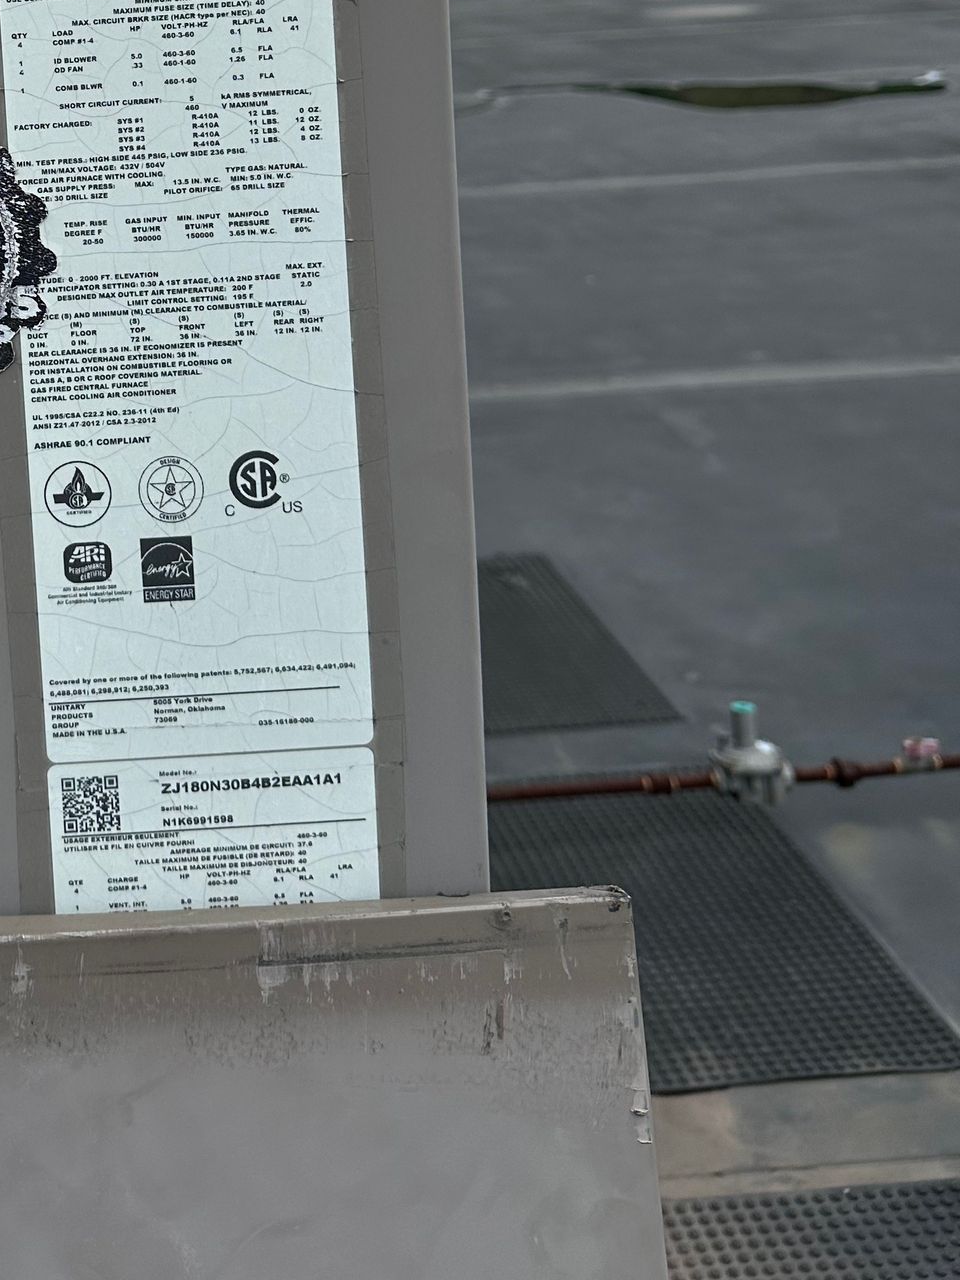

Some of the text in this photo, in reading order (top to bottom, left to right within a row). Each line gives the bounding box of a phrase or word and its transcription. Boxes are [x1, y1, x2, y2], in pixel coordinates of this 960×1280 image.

[112, 6, 152, 15] MAXIMUM
[153, 4, 175, 12] FUSE
[176, 3, 195, 11] SIZE
[196, 2, 219, 11] (TIME
[59, 102, 86, 110] SHORT
[87, 99, 120, 108] CIRCUIT
[191, 112, 219, 120] R-410A
[14, 122, 51, 131] FACTORY
[224, 165, 246, 173] TYPE
[227, 210, 269, 218] MANIFOLD
[281, 207, 320, 215] THERMAL
[228, 219, 270, 227] PRESSURE
[30, 380, 148, 394] GAS FIRED CENTRAL FURNACE
[30, 388, 177, 403] CENTRAL COOLING AIR CONDITIONER
[34, 435, 151, 450] ASHRAE 90.1 COMPLIANT
[281, 500, 303, 514] US
[144, 589, 174, 601] ENERGY
[174, 588, 194, 599] STAR
[50, 703, 86, 712] UNITARY
[187, 705, 226, 713] Oklahoma
[51, 712, 94, 721] PRODUCTS
[51, 721, 79, 729] GROUP
[52, 730, 75, 739] MADE
[86, 728, 103, 737] THE
[161, 772, 341, 794] ZJ180N30B4B2EAA1A1
[162, 814, 234, 827] N1K6991598
